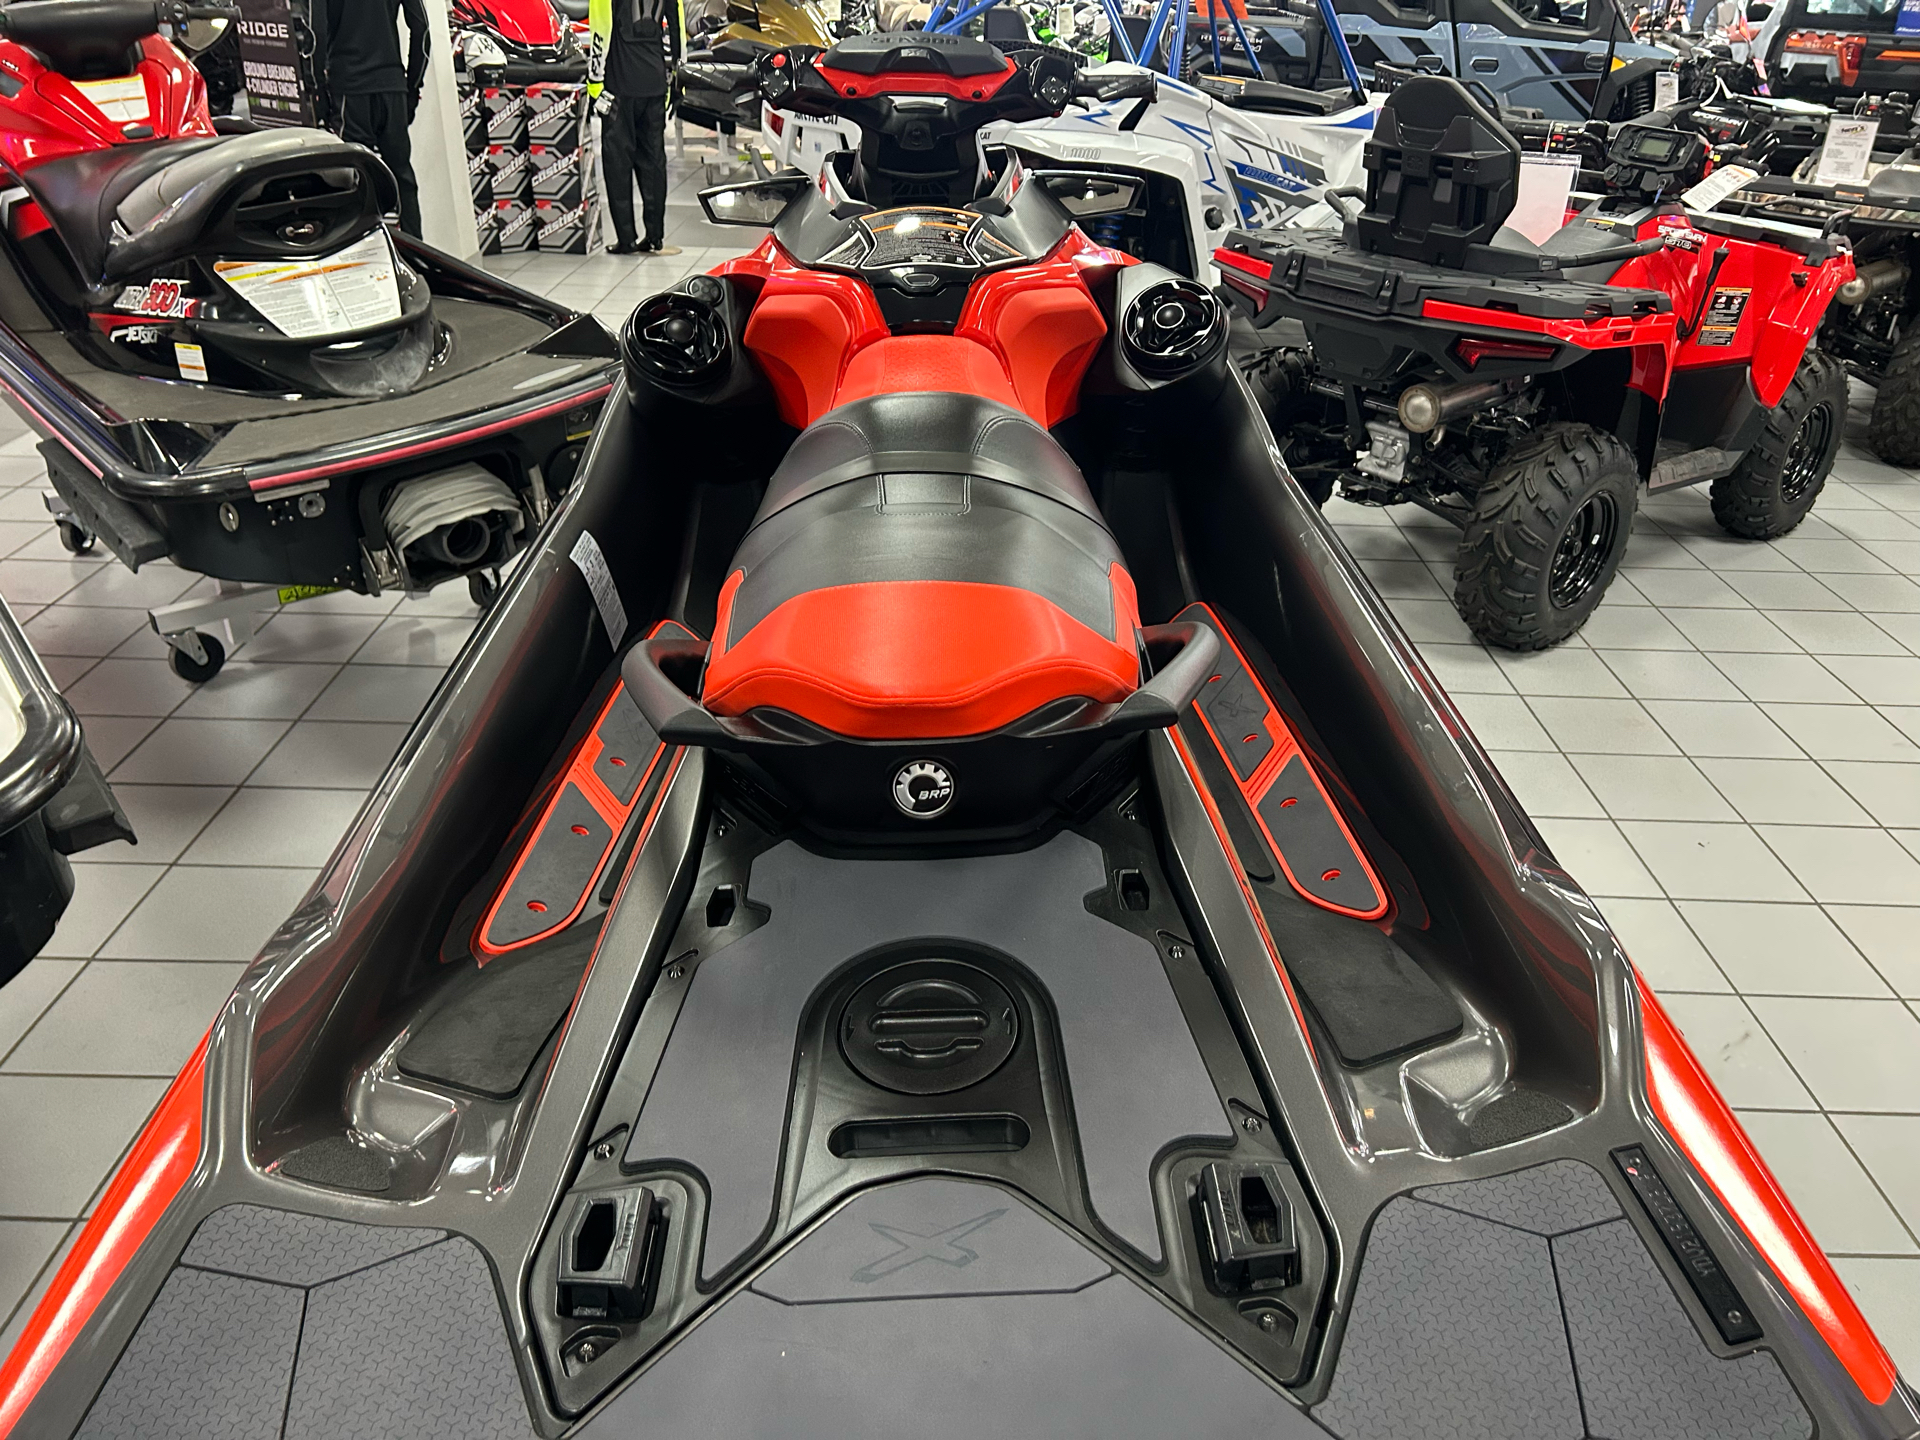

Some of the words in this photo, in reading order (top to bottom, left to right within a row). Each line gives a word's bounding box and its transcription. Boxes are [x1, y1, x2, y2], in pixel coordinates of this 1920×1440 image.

[237, 21, 289, 38] RIDGE
[591, 32, 603, 76] FXR
[1070, 147, 1101, 160] 1000
[1243, 166, 1296, 191] WILDCAT
[1658, 225, 1708, 243] SPORTSMAN
[1665, 236, 1692, 250] 570
[126, 326, 145, 342] JET
[918, 787, 951, 800] BRP
